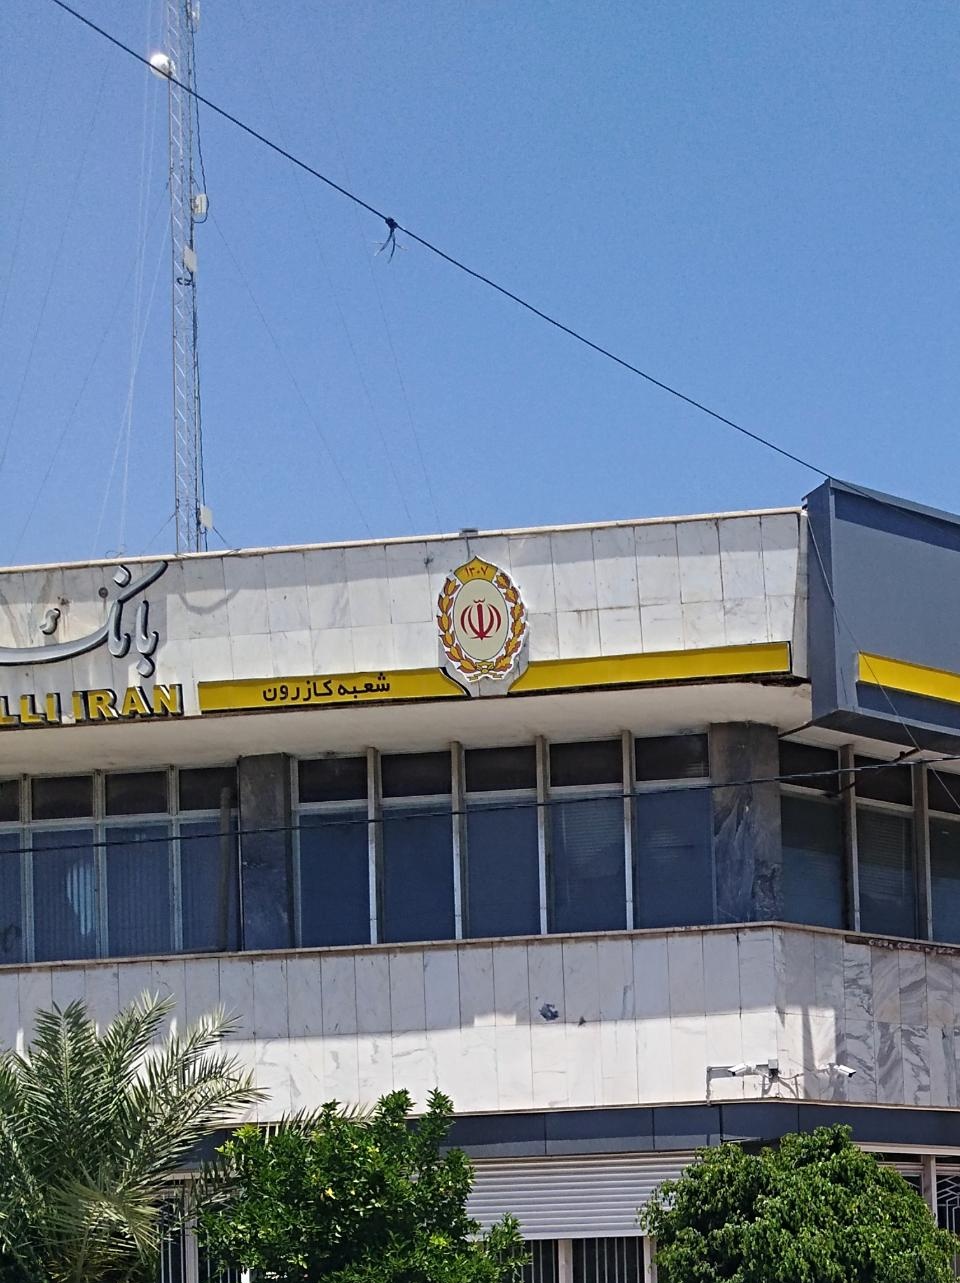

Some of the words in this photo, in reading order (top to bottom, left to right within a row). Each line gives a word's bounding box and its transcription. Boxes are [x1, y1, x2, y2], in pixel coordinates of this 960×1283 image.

[465, 566, 489, 577] ۱۳۰۷
[262, 680, 334, 701] کازرون
[338, 672, 391, 699] شعبه
[72, 684, 183, 722] IRAN
